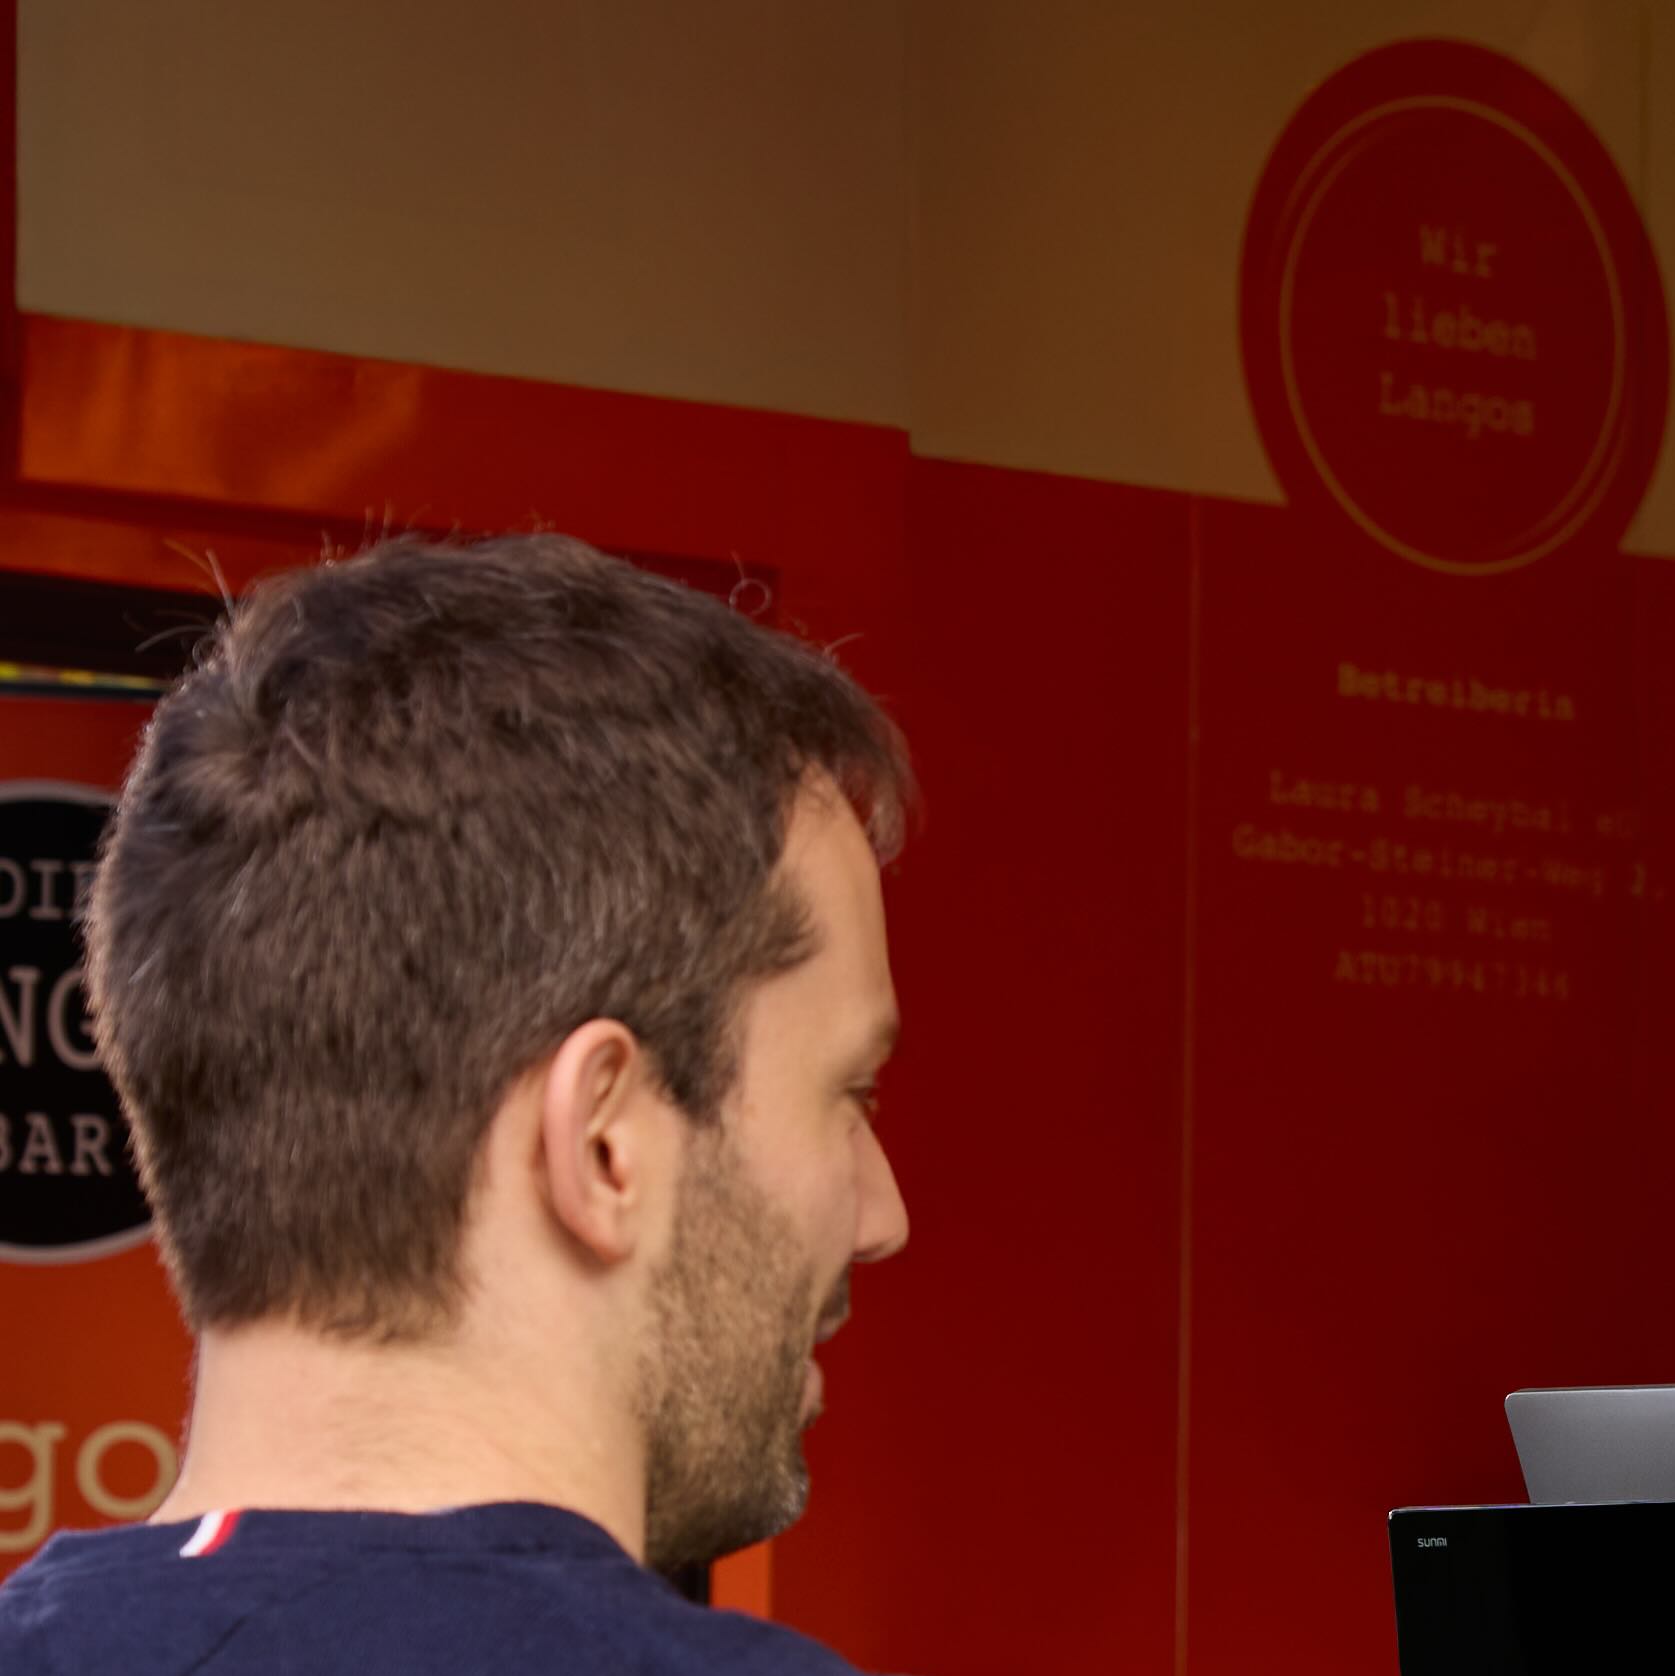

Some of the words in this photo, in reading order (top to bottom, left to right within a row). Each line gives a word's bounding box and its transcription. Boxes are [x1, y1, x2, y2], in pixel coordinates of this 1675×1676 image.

[1419, 223, 1499, 279] Wir
[1382, 291, 1538, 361] lieben
[1378, 369, 1536, 442] Langos
